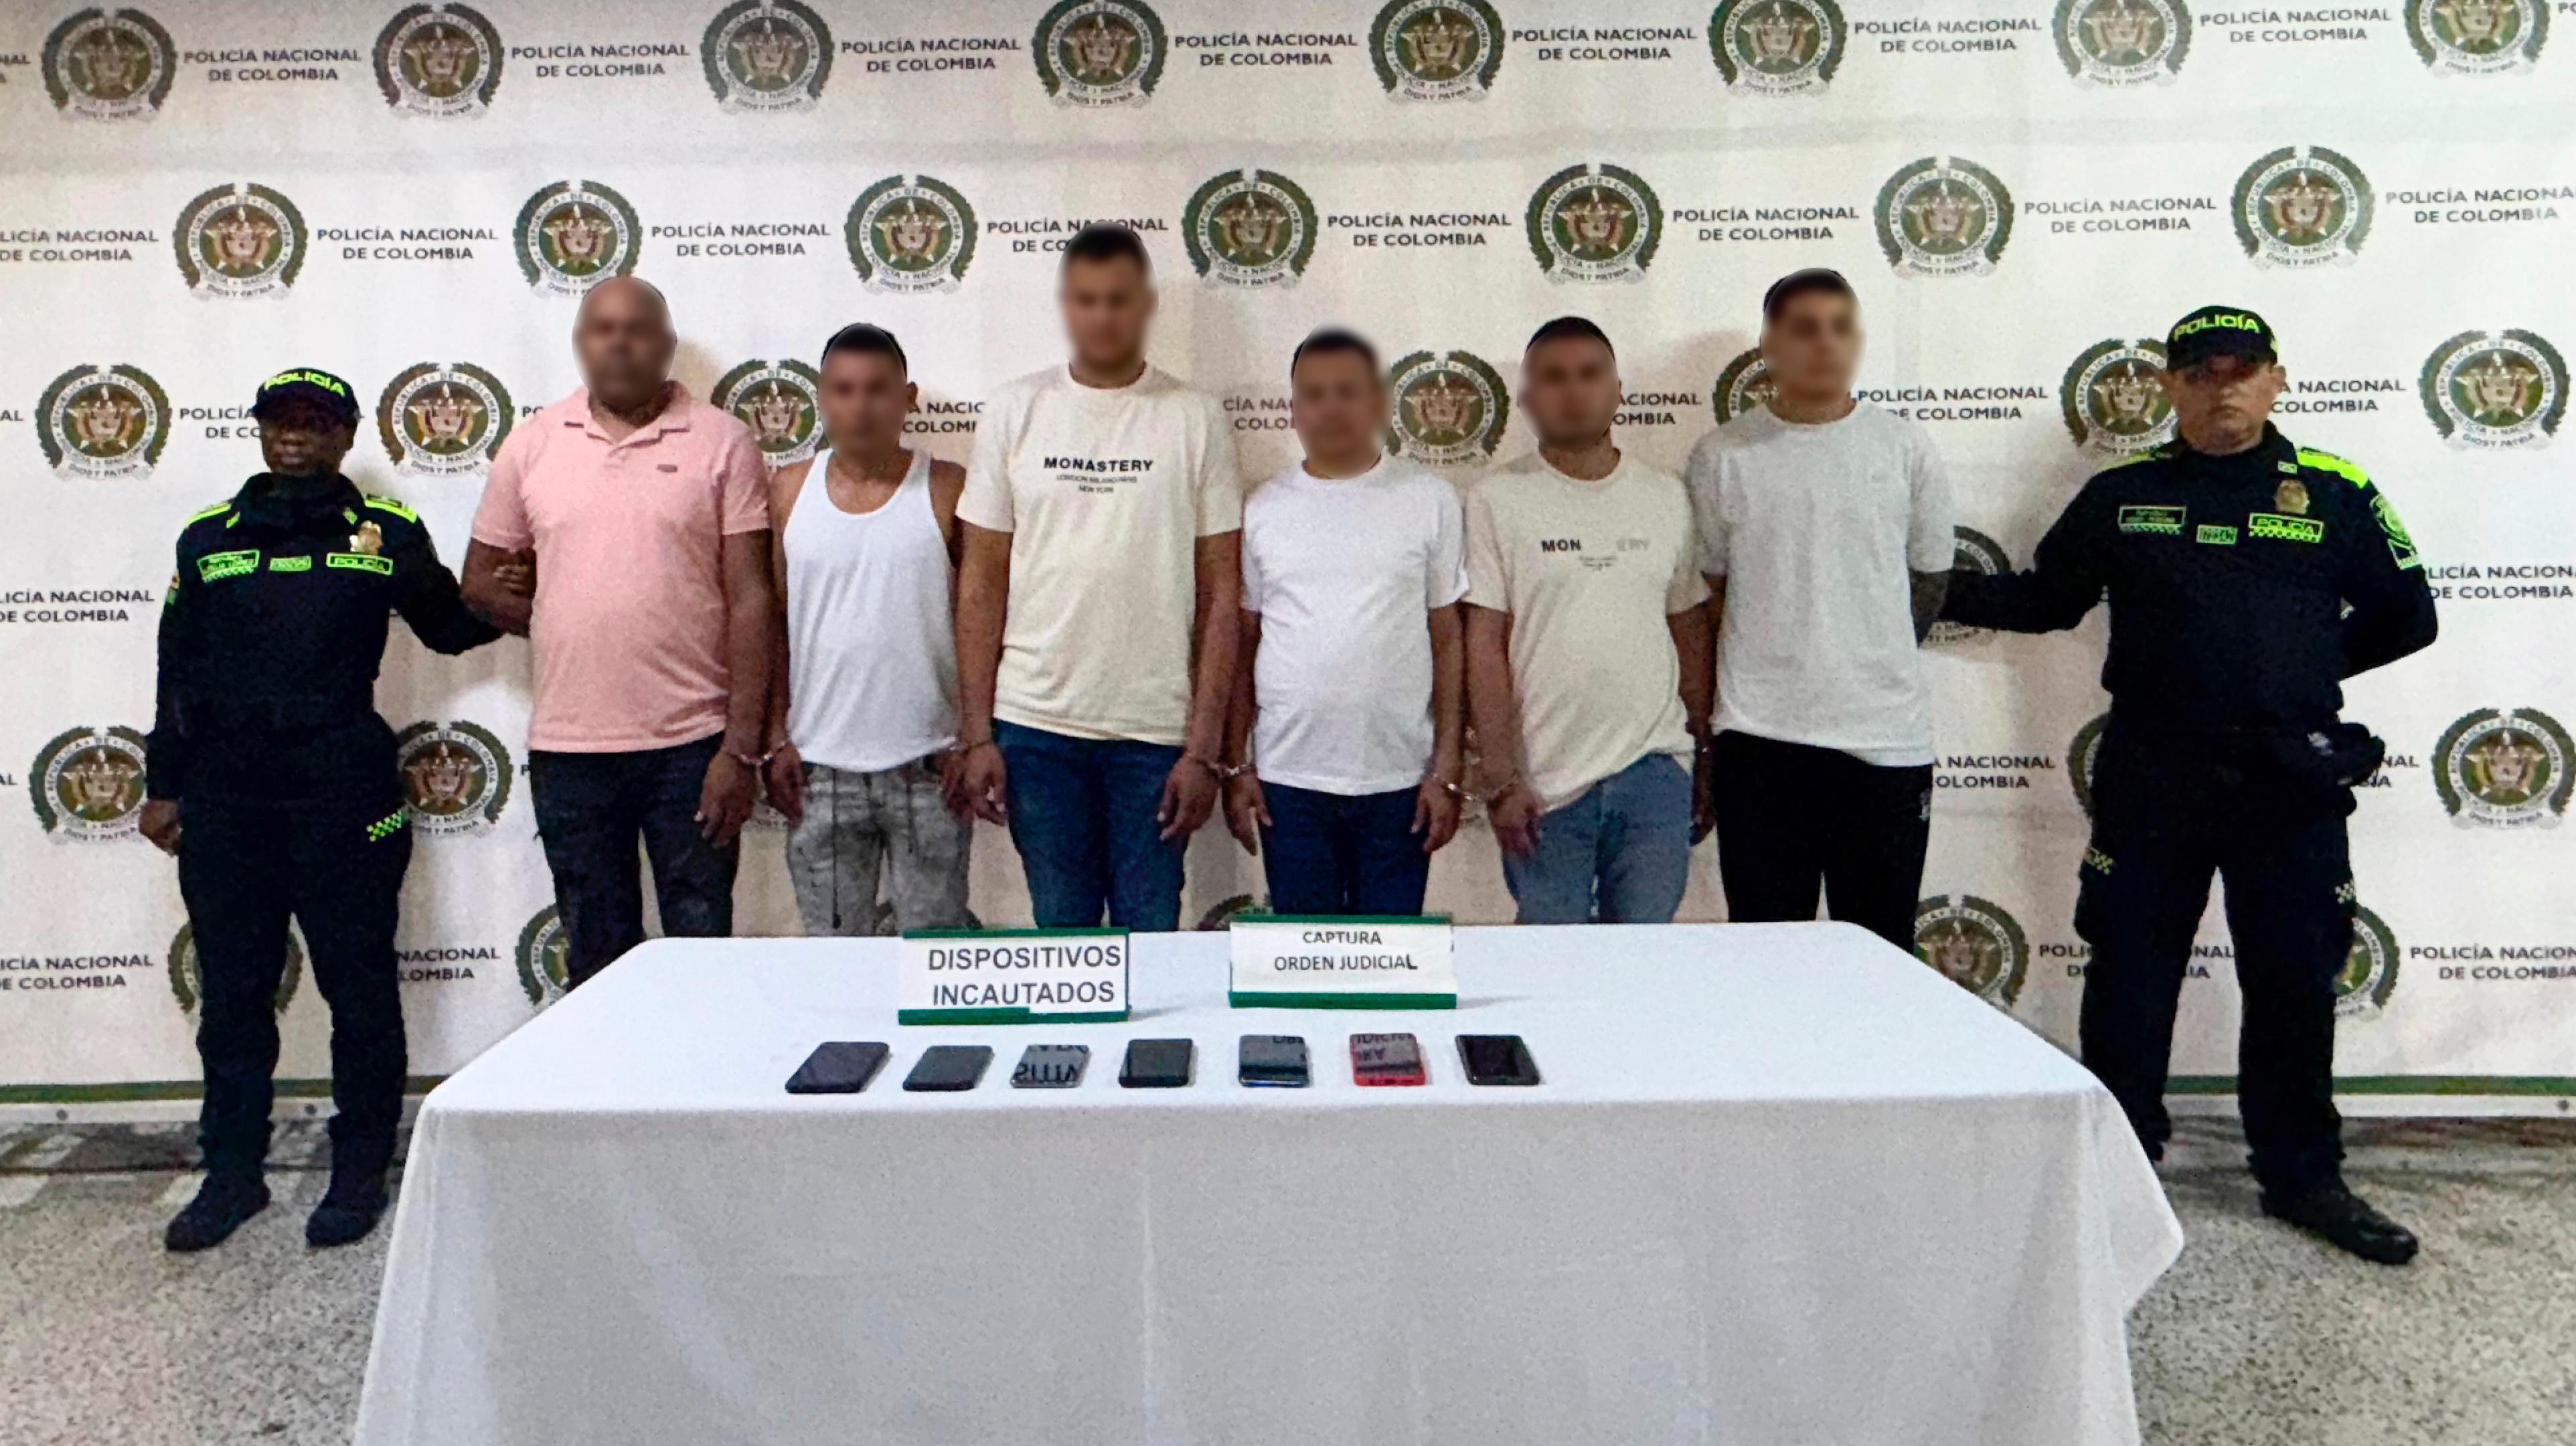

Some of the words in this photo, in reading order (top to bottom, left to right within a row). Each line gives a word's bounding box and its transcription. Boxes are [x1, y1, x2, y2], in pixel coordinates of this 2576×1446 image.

[2200, 9, 2281, 26] POLICÍA
[2287, 9, 2391, 22] NACIONAL
[1854, 18, 1931, 34] POLICÍA
[1938, 19, 2041, 33] NACIONAL
[1175, 32, 1250, 48] POLICÍA
[1257, 34, 1357, 46] NACIONAL
[1512, 26, 1589, 42] POLICÍA
[1595, 28, 1696, 41] NACIONAL
[2231, 31, 2254, 42] DE
[2262, 28, 2367, 42] COLOMBIA
[512, 43, 584, 58] POLICÍA
[591, 44, 689, 57] NACIONAL
[841, 37, 914, 54] POLICÍA
[920, 39, 1021, 52] NACIONAL
[1881, 39, 1905, 53] DE
[1912, 39, 2016, 52] COLOMBIA
[184, 48, 258, 63] POLICÍA
[263, 49, 361, 62] NACIONAL
[1200, 54, 1224, 66] DE
[1230, 53, 1332, 65] COLOMBIA
[1539, 48, 1562, 60] DE
[1570, 48, 1670, 60] COLOMBIA
[536, 66, 559, 77] DE
[566, 64, 665, 76] COLOMBIA
[867, 61, 890, 72] DE
[896, 58, 995, 72] COLOMBIA
[208, 69, 232, 81] DE
[238, 68, 337, 81] COLOMBIA
[2387, 187, 2467, 204] POLICÍA
[2475, 187, 2576, 202] NACIONA
[2025, 199, 2103, 214] POLICÍA
[2111, 197, 2217, 211] NACIONAL
[1327, 213, 1403, 227] POLICÍA
[1411, 214, 1511, 226] NACIONAL
[1673, 207, 1749, 222] POLICÍA
[1756, 207, 1858, 220] NACIONAL
[2415, 211, 2439, 223] DE
[2447, 208, 2557, 222] COLOMBIA
[652, 222, 725, 238] POLICÍA
[732, 224, 830, 236] NACIONAL
[987, 218, 1061, 233] POLICÍA
[2052, 222, 2075, 232] DE
[2083, 218, 2190, 232] COLOMBIA
[57, 230, 159, 242] NACIONAL
[318, 226, 394, 240] POLICÍA
[401, 228, 497, 240] NACIONAL
[1354, 234, 1377, 246] DE
[1384, 233, 1485, 246] COLOMBIA
[1699, 229, 1722, 241] DE
[1729, 227, 1833, 240] COLOMBIA
[677, 244, 699, 256] DE
[706, 243, 805, 256] COLOMBIA
[1013, 240, 1036, 252] DE
[0, 250, 22, 261] DE
[29, 249, 132, 261] COLOMBIA
[343, 248, 366, 259] DE
[374, 248, 473, 259] COLOMBIA
[2298, 380, 2405, 393] NACIONAL
[1857, 386, 1937, 402] POLICÍA
[1944, 387, 2048, 400] NACIONAL
[2271, 398, 2378, 414] COLOMBIA
[1917, 407, 2022, 420] COLOMBIA
[206, 427, 229, 438] DE
[904, 421, 976, 434] COLOM
[1044, 457, 1154, 473] MONASTERY
[2488, 566, 2576, 578] NACION
[50, 590, 154, 602] NACIONAL
[2459, 586, 2573, 599] COLOMBIA
[23, 610, 128, 622] COLOMBIA
[1948, 755, 2056, 770] NACIONAL
[1303, 931, 1382, 945] CAPTURA
[929, 945, 1121, 970] DISPOSITIVOS
[2411, 946, 2494, 960] POLICÍA
[46, 955, 153, 969] NACIONAL
[1274, 956, 1334, 971] ORDEN
[1339, 953, 1419, 971] JUDICIAL
[2440, 967, 2464, 979] DE
[19, 975, 126, 989] COLOMBIA
[933, 980, 1115, 1006] INCAUTADOS
